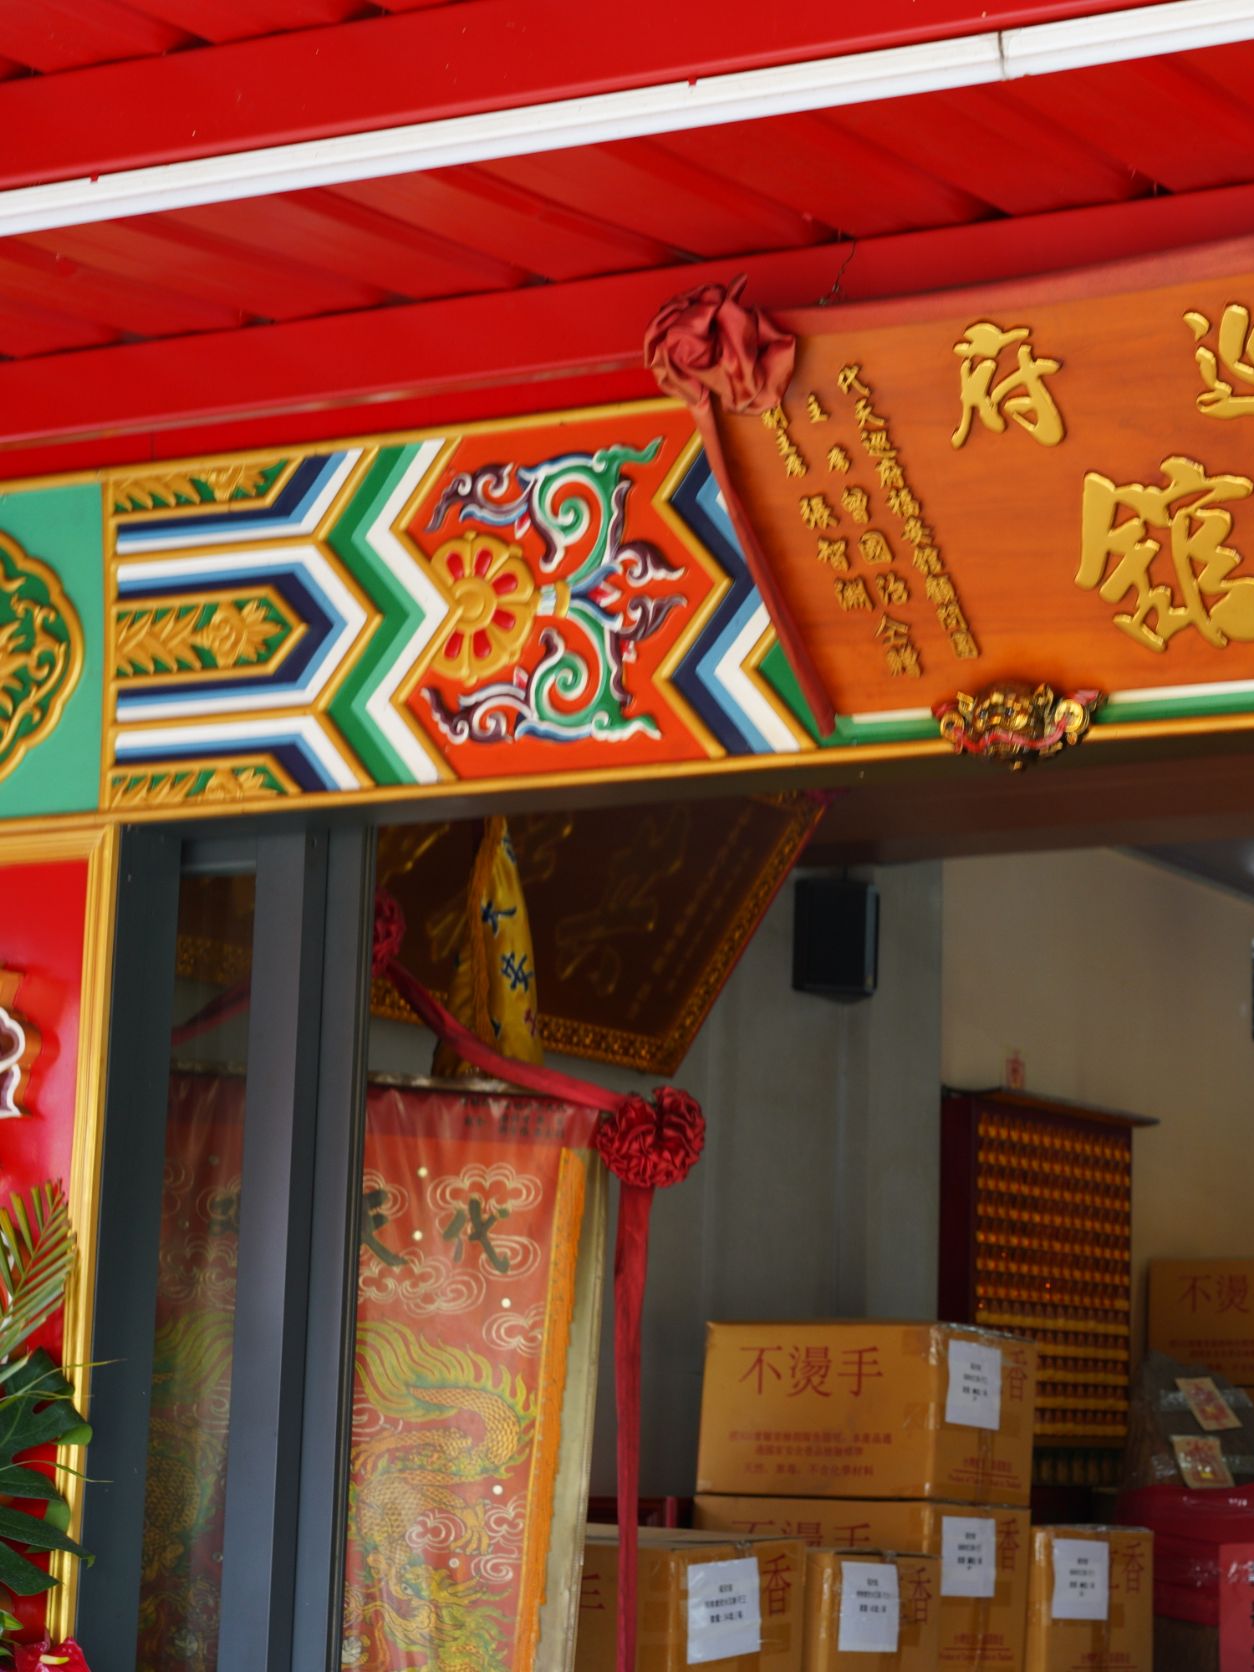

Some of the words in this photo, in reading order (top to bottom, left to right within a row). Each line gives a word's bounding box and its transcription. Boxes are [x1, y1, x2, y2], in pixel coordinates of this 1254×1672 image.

[739, 1345, 884, 1399] 不燙手
[998, 1518, 1020, 1572] 香
[1110, 1541, 1145, 1595] 香
[761, 1553, 792, 1617] 香
[900, 1566, 933, 1625] 香
